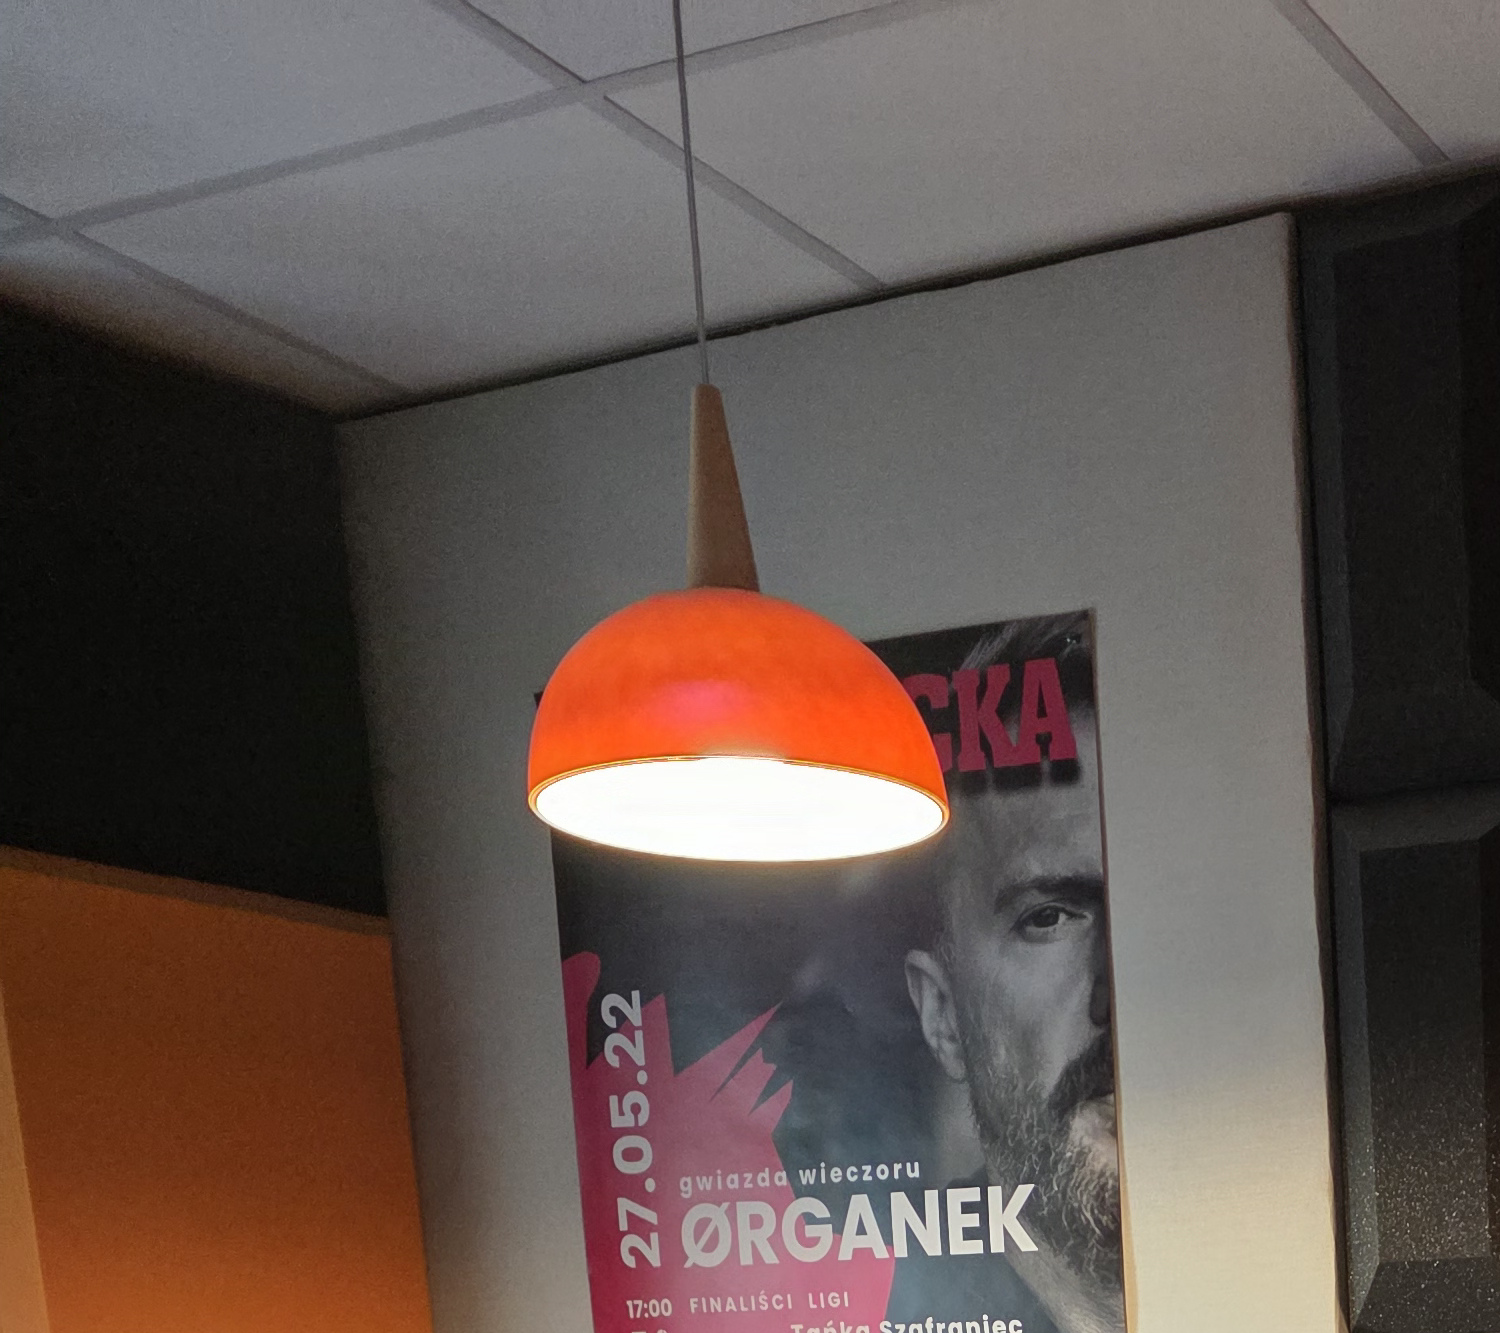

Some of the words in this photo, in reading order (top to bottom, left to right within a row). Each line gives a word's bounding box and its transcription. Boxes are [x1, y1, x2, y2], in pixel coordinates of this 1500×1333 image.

[600, 988, 662, 1270] 27.05.22
[679, 1166, 789, 1198] gwiazda
[798, 1158, 921, 1187] wieczoru
[680, 1182, 1039, 1269] ØRGANEK
[626, 1297, 673, 1319] 17:00
[689, 1289, 793, 1315] FINALIŚCI
[808, 1291, 850, 1310] LIGI
